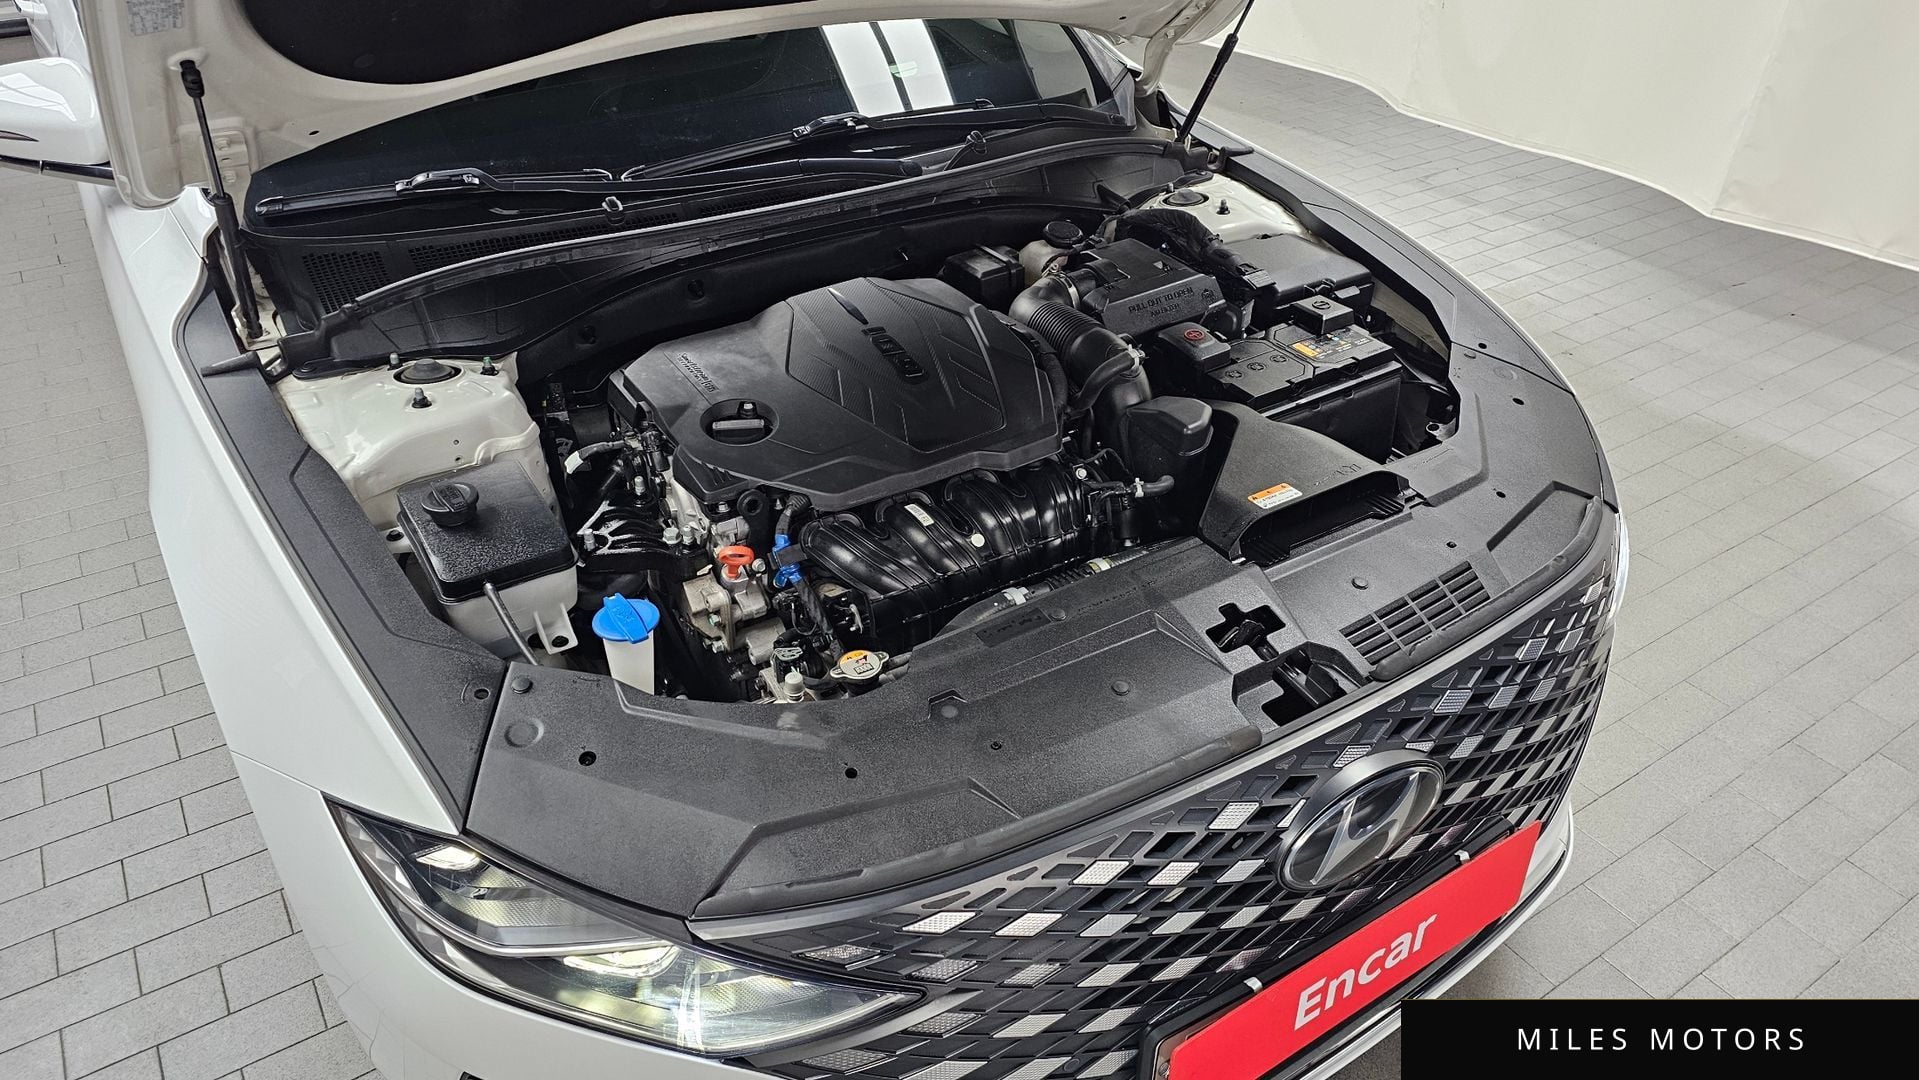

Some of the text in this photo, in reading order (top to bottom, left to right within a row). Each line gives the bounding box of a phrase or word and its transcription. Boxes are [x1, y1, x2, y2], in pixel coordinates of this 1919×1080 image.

[1147, 296, 1162, 307] OUT
[1163, 292, 1173, 301] TO
[1173, 286, 1193, 298] OPEN
[1294, 914, 1437, 1031] Encar
